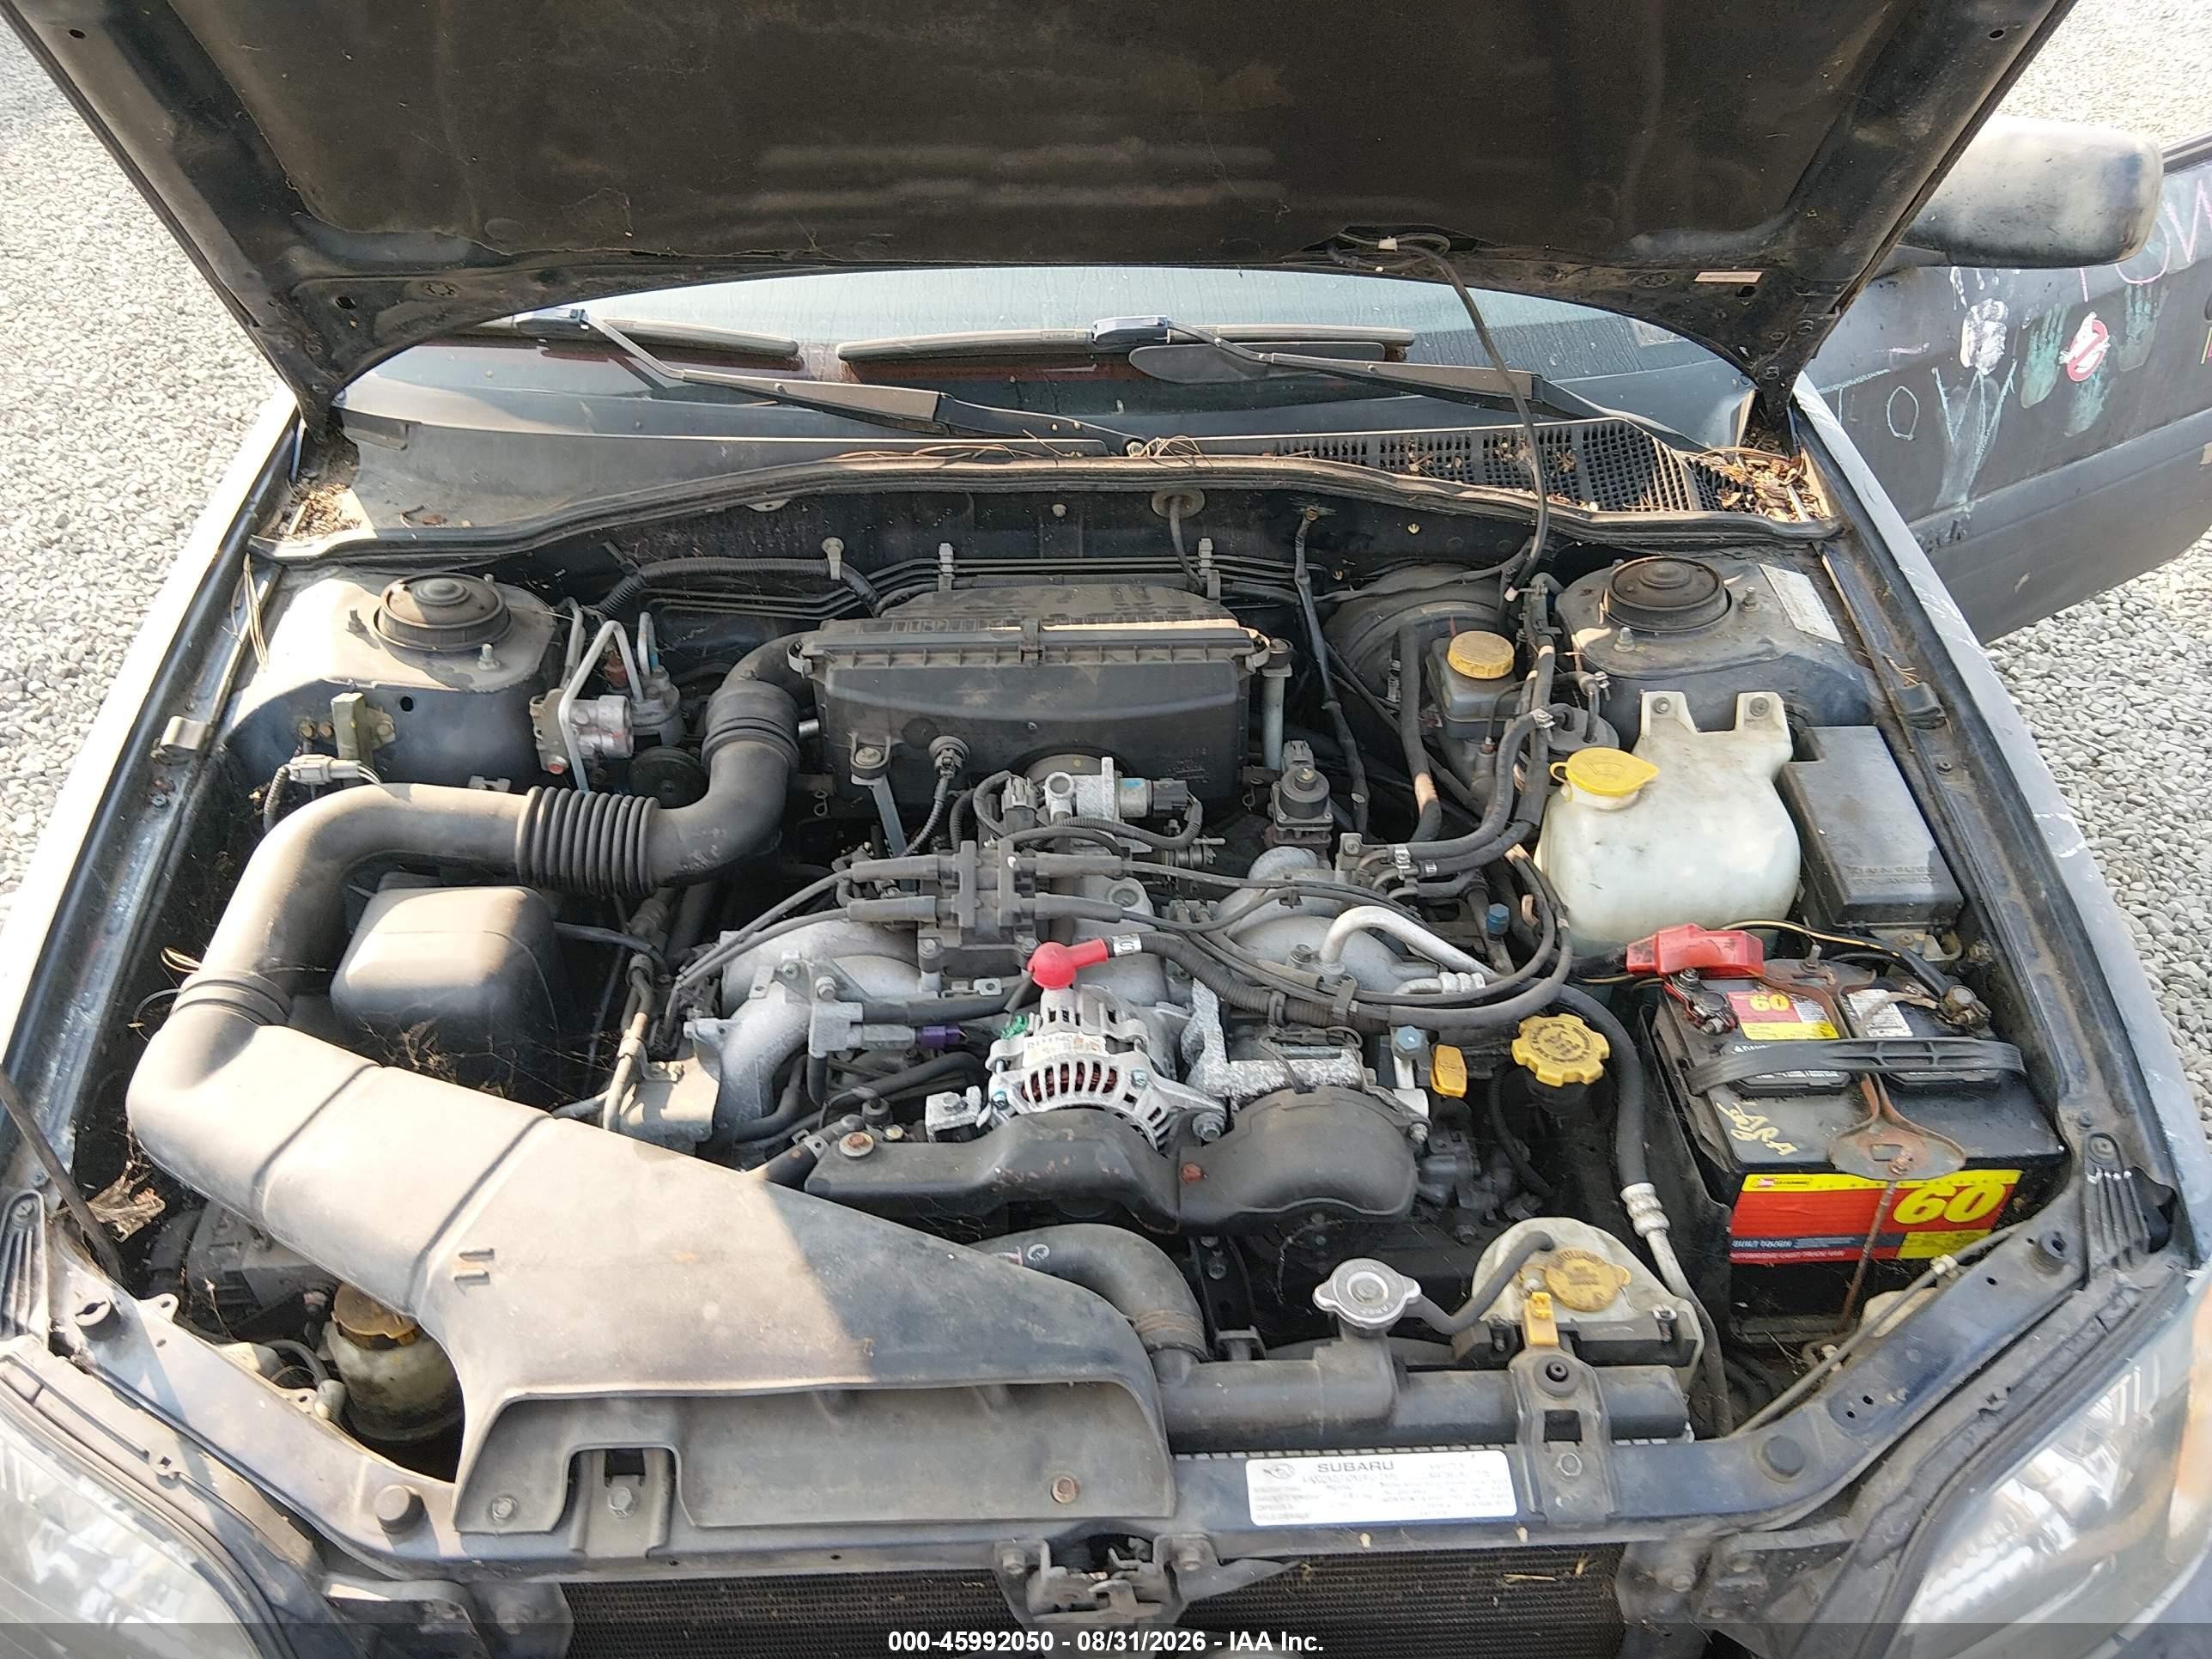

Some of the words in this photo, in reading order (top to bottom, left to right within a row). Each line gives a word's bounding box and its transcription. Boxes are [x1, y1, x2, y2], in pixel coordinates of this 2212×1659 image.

[1749, 994, 1790, 1012] 60
[1893, 1182, 2007, 1224] 60
[1316, 1460, 1395, 1474] SUBARU
